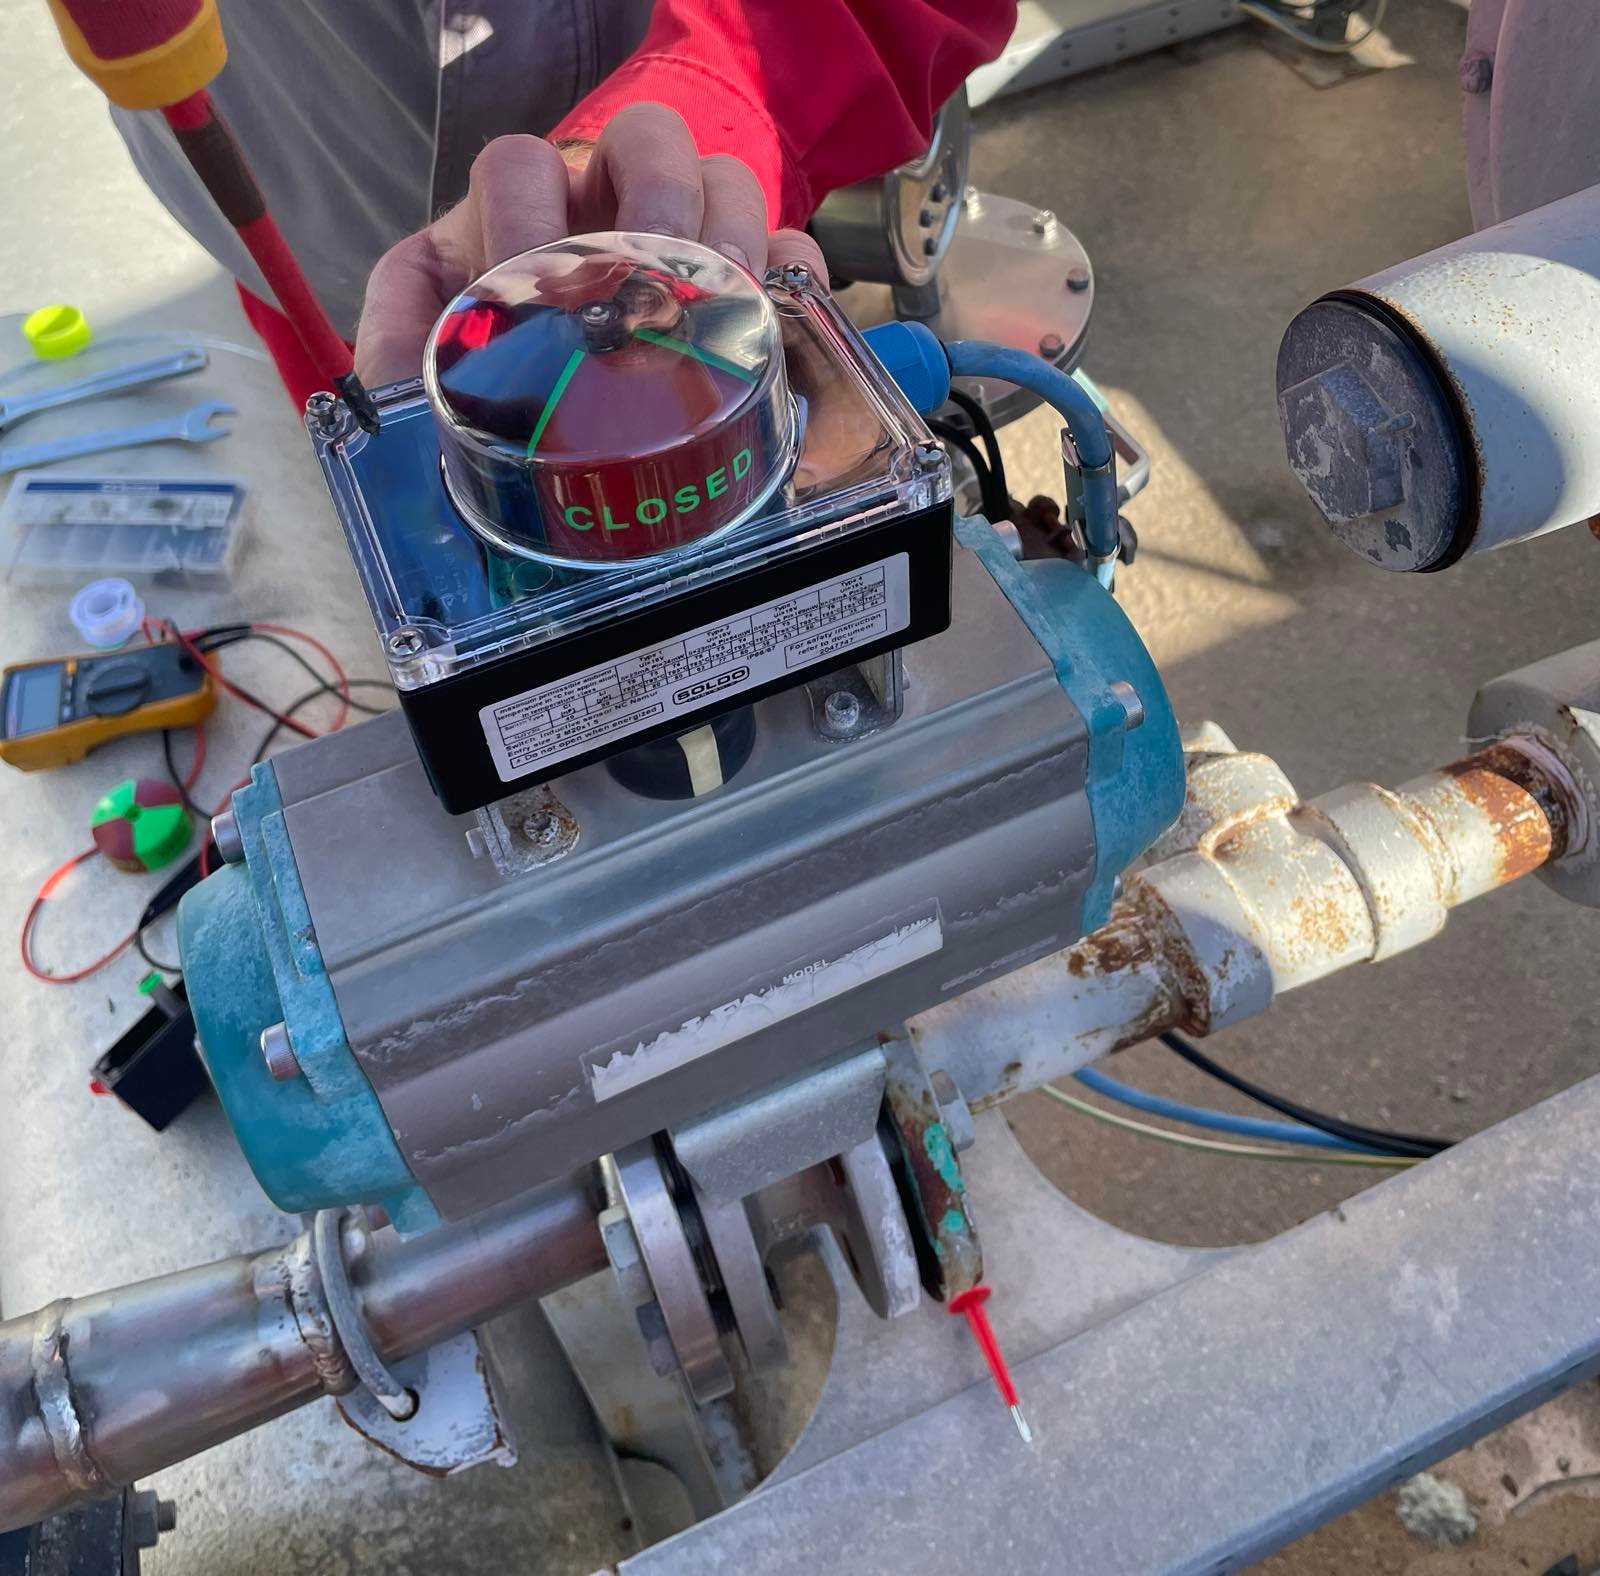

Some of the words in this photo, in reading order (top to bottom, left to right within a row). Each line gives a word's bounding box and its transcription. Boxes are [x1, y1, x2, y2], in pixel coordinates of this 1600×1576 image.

[563, 447, 753, 532] CLOSED
[789, 642, 803, 651] For
[806, 630, 833, 646] safety
[834, 612, 881, 634] instruction
[798, 643, 817, 655] refer
[820, 639, 828, 647] to
[831, 622, 873, 642] document
[677, 668, 745, 700] SOLDO
[539, 719, 580, 738] Inductive
[582, 707, 612, 722] sensor
[614, 701, 627, 710] NC
[630, 690, 658, 704] Namur
[507, 744, 530, 758] Entry
[524, 751, 538, 760] Do
[540, 745, 556, 754] not
[558, 735, 582, 748] open
[584, 724, 609, 738] when
[611, 706, 657, 728] energized
[782, 958, 832, 985] MODEL
